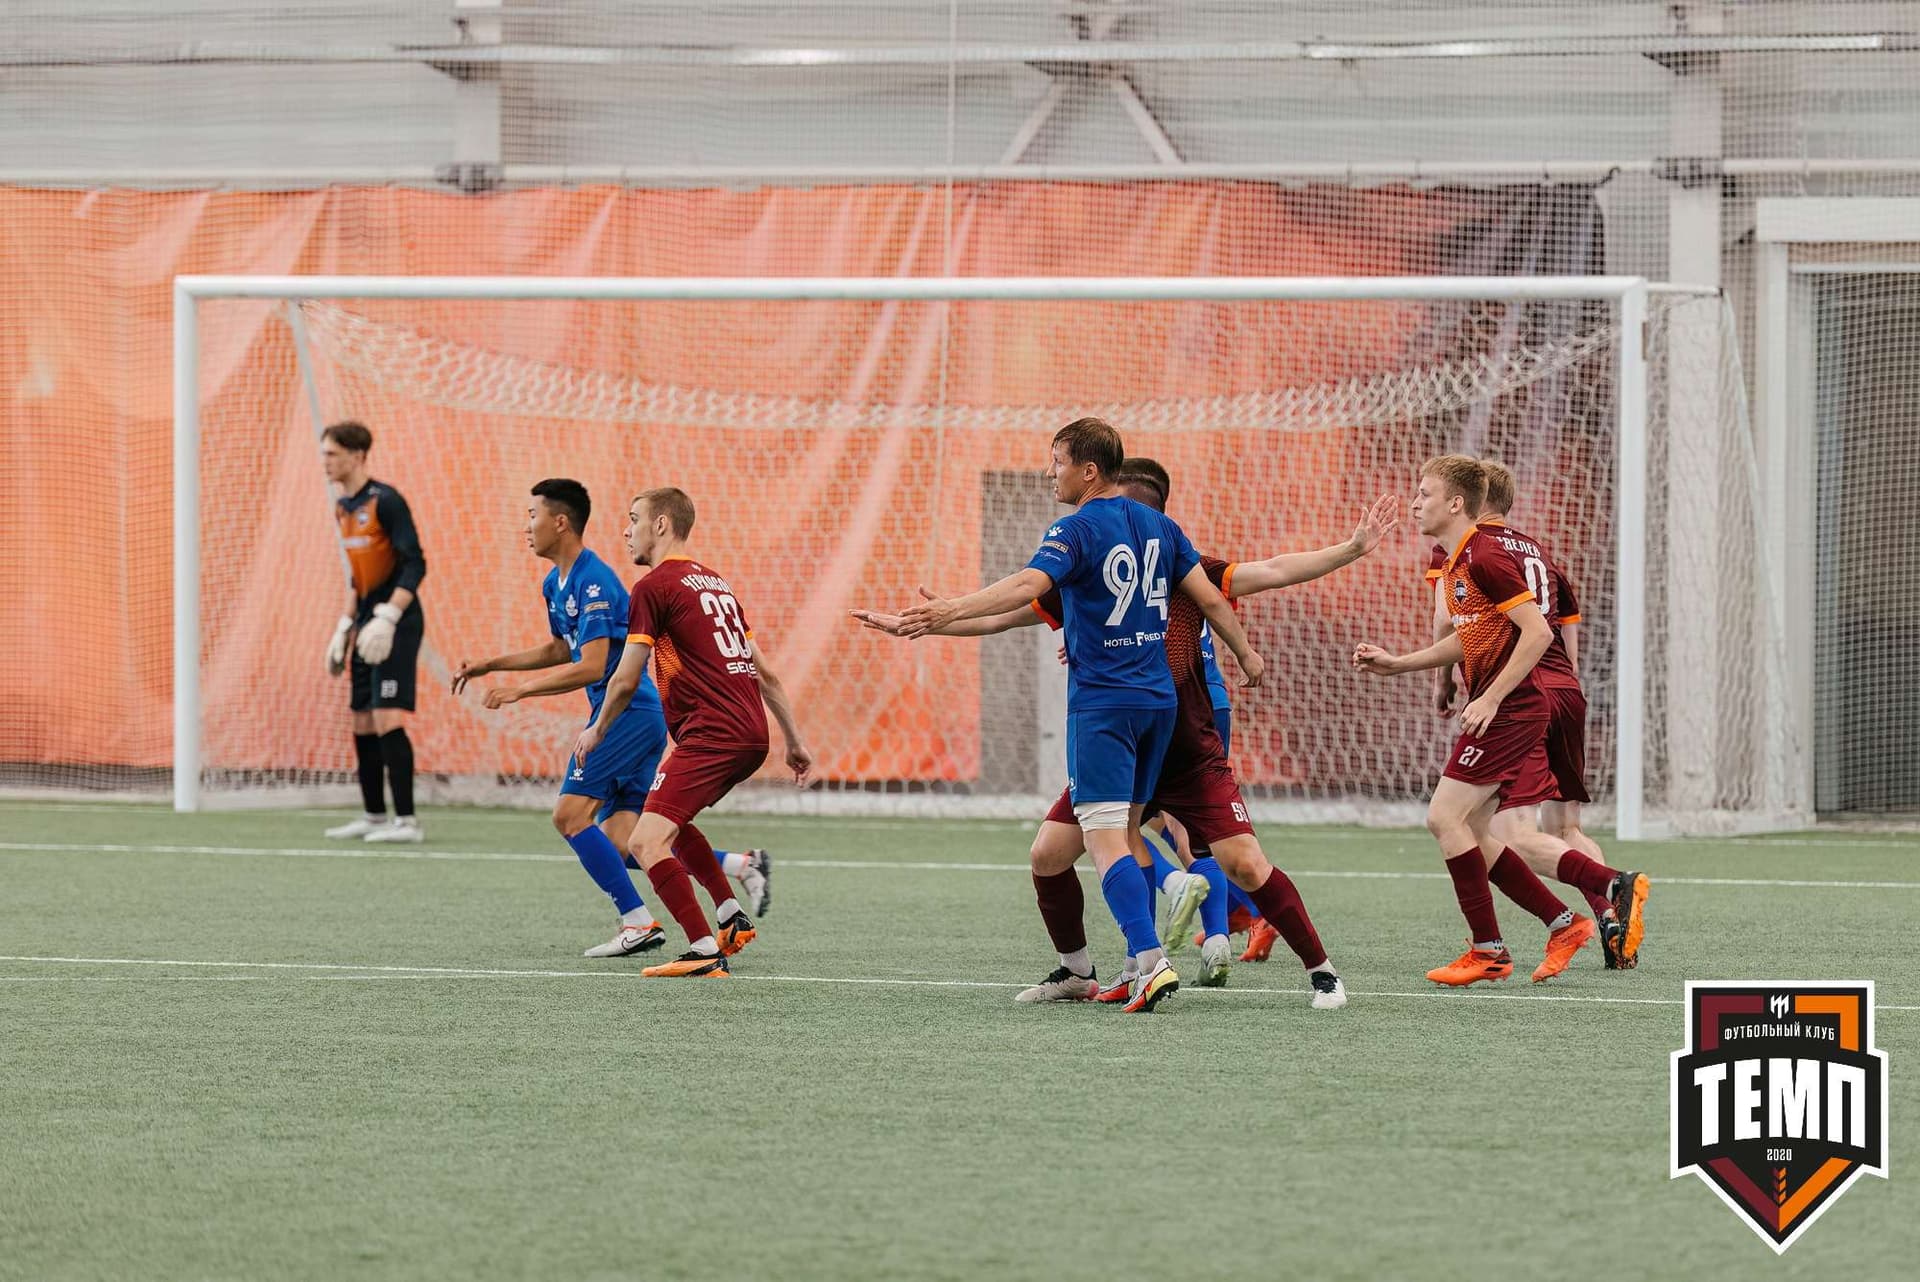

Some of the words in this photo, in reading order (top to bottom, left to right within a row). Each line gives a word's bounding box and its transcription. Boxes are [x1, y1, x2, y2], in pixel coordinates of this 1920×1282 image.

[1103, 539, 1168, 626] 94
[700, 592, 752, 659] 33
[1104, 638, 1135, 648] HOTEL
[1135, 631, 1161, 647] FRED
[1457, 745, 1484, 767] 27
